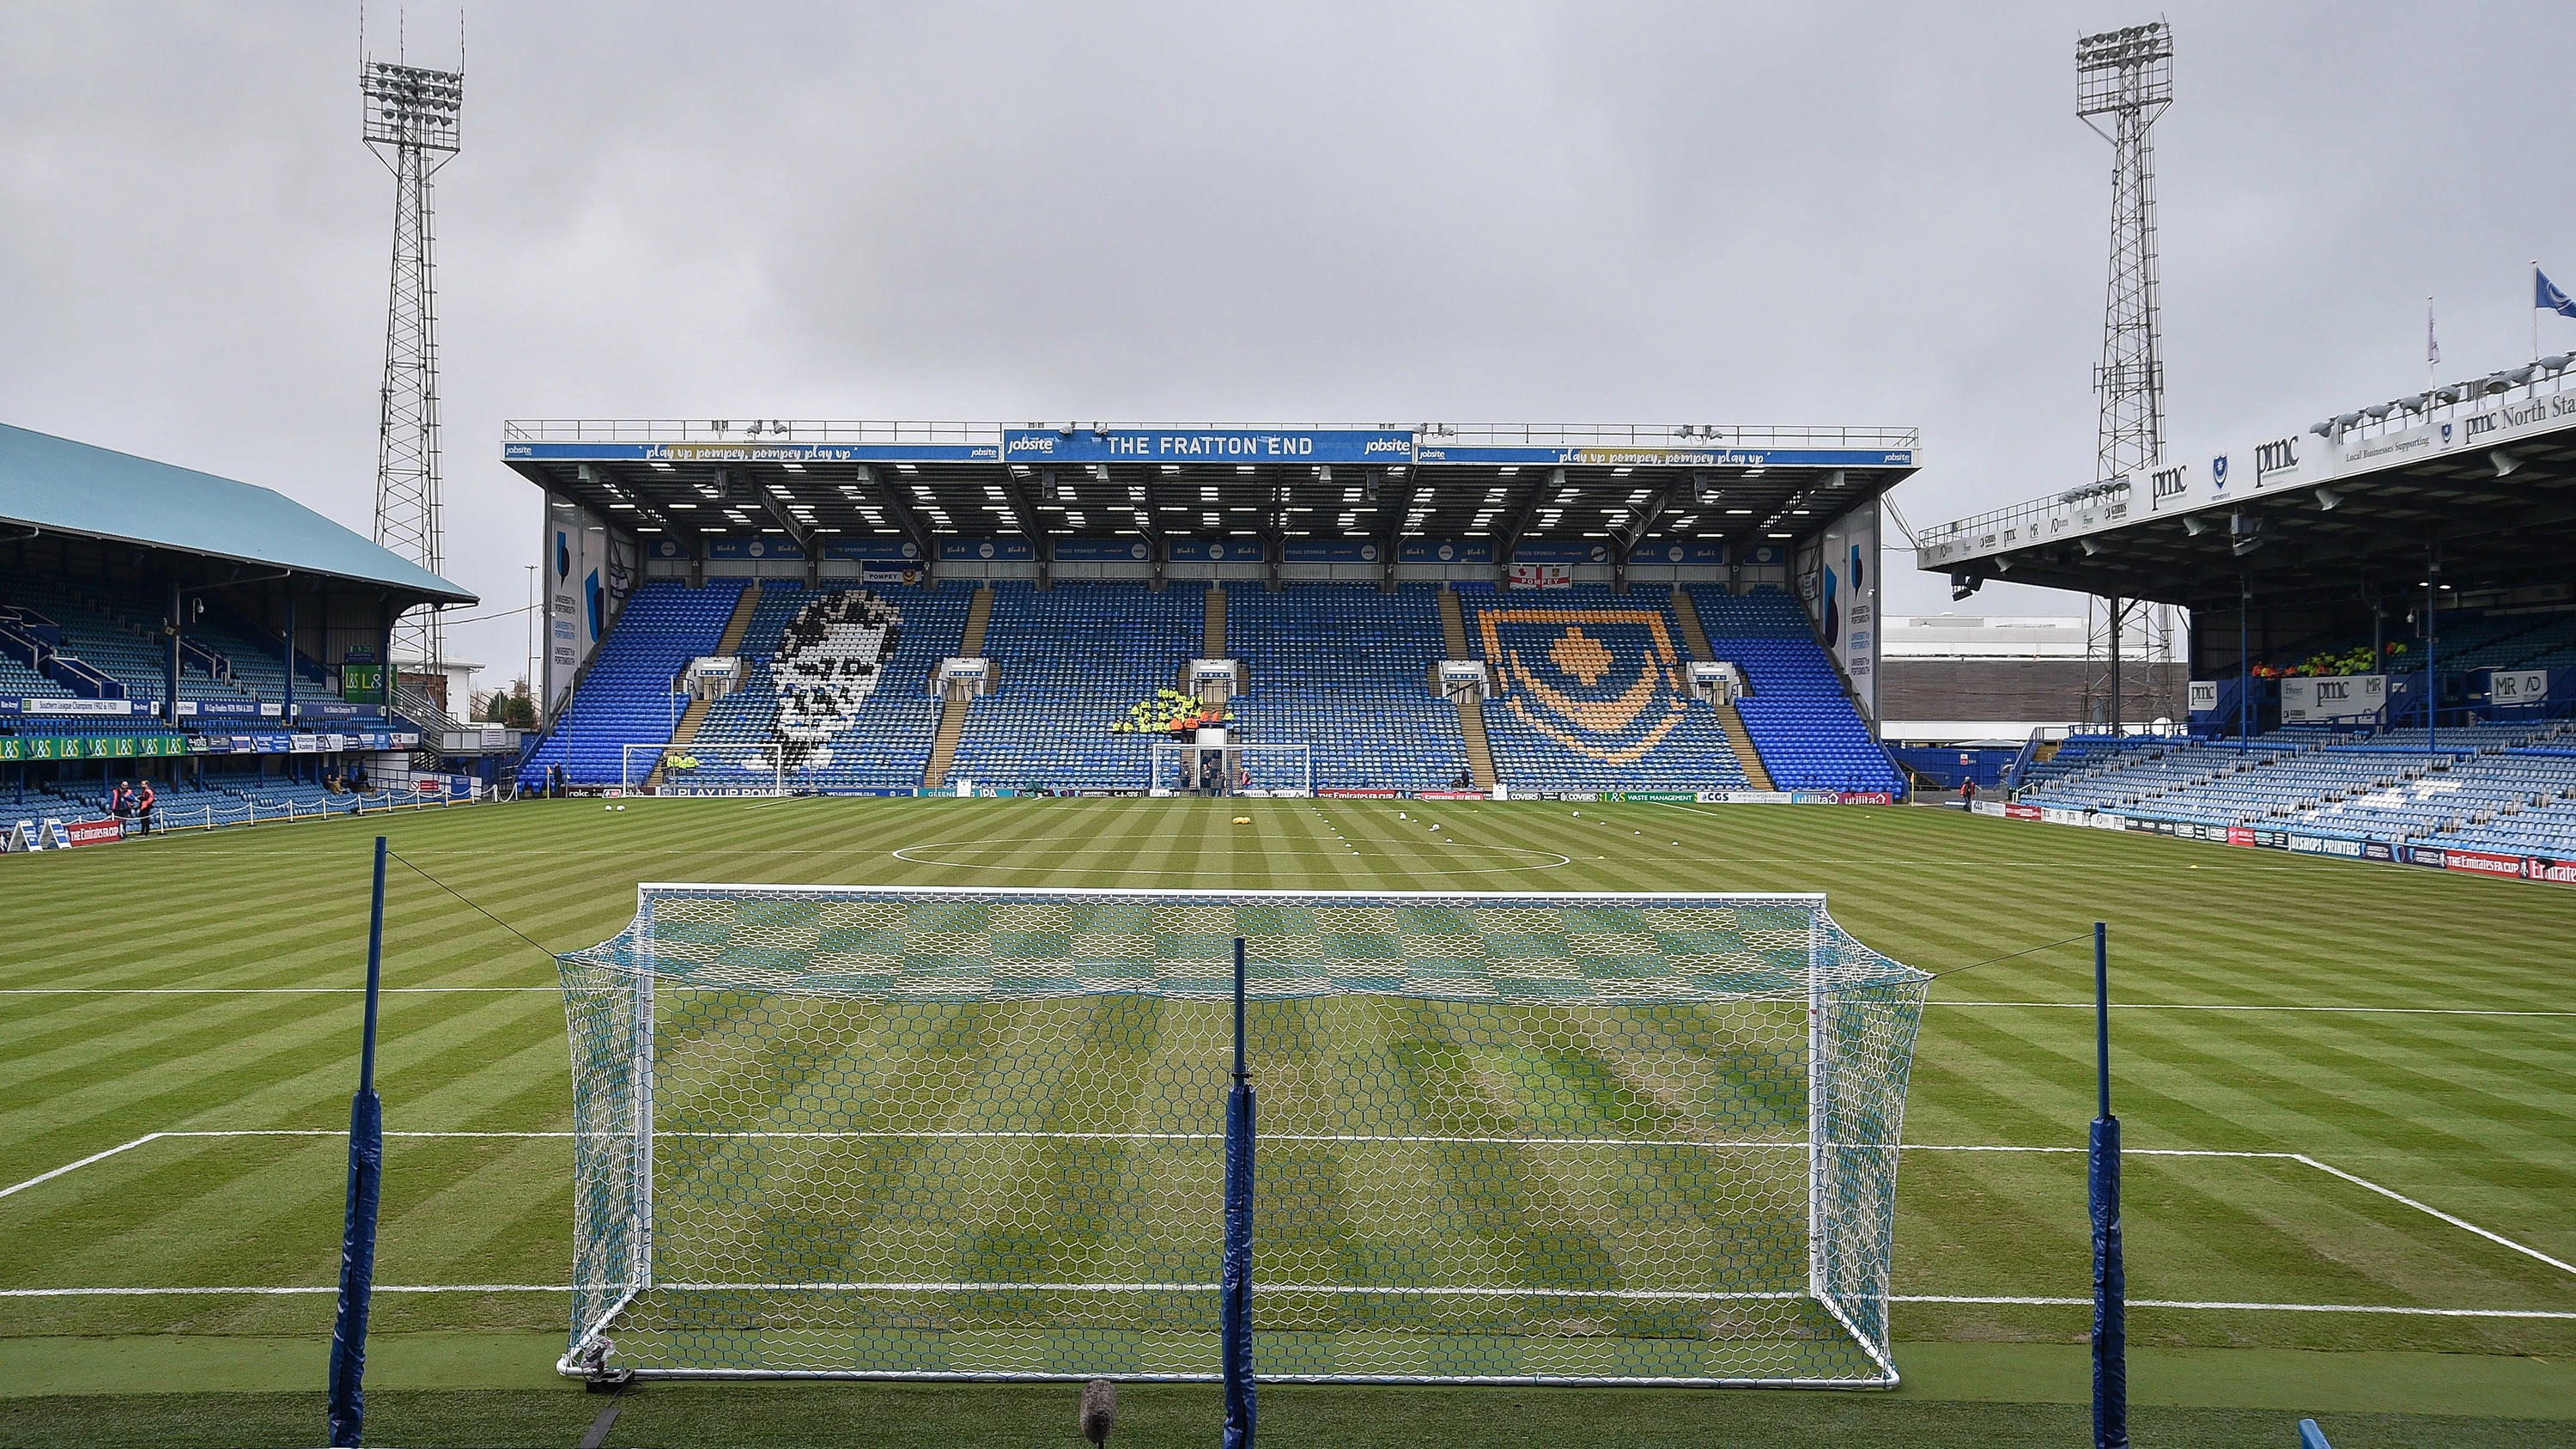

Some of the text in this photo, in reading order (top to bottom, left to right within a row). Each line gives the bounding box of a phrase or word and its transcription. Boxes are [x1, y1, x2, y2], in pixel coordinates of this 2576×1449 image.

[2465, 395, 2576, 445] pmc North Sta
[506, 445, 532, 455] jobsite
[646, 443, 674, 460] play
[677, 448, 693, 460] up
[752, 448, 801, 460] pompey
[805, 444, 833, 460] play
[835, 448, 851, 460] up
[970, 447, 997, 458] jobsite
[1007, 437, 1054, 454] jobsite
[1107, 436, 1313, 455] THE FRATTON END
[1364, 438, 1410, 455] jobsite
[2346, 450, 2361, 463] Local
[2364, 443, 2394, 460] Businesses
[2395, 435, 2430, 453] Supporting
[1419, 449, 1445, 460] jobsite
[1558, 448, 1587, 464] play
[1590, 454, 1606, 464] up
[1666, 454, 1715, 465] pompey
[1717, 449, 1746, 465] play
[1748, 454, 1764, 465] up
[1884, 453, 1910, 463] jobsite
[2255, 435, 2300, 489] pmc
[2151, 464, 2188, 512] pmc
[1522, 577, 1559, 586] POMPEY
[346, 673, 358, 688] L&S
[2366, 678, 2382, 692] MR
[2494, 677, 2517, 695] MR
[2191, 685, 2215, 706] pmc
[2316, 681, 2350, 708] pmc
[39, 701, 58, 709] Southern
[58, 701, 71, 711] League
[73, 701, 93, 711] Champions
[0, 740, 19, 758] L&S
[32, 740, 51, 758] L&S
[61, 740, 78, 758] L&S
[89, 739, 106, 757] L&S
[116, 739, 132, 756] L&S
[142, 738, 158, 755] L&S
[167, 738, 181, 754] L&S
[979, 788, 998, 798] IPA
[1708, 792, 1729, 801] CGS
[1797, 794, 1829, 804] utilita
[70, 831, 81, 841] THE
[81, 827, 102, 841] Emirates
[2291, 836, 2323, 852] BISHOPS
[2324, 838, 2360, 856] PRINTERS
[2448, 855, 2518, 874] THE Emirates FA CUP
